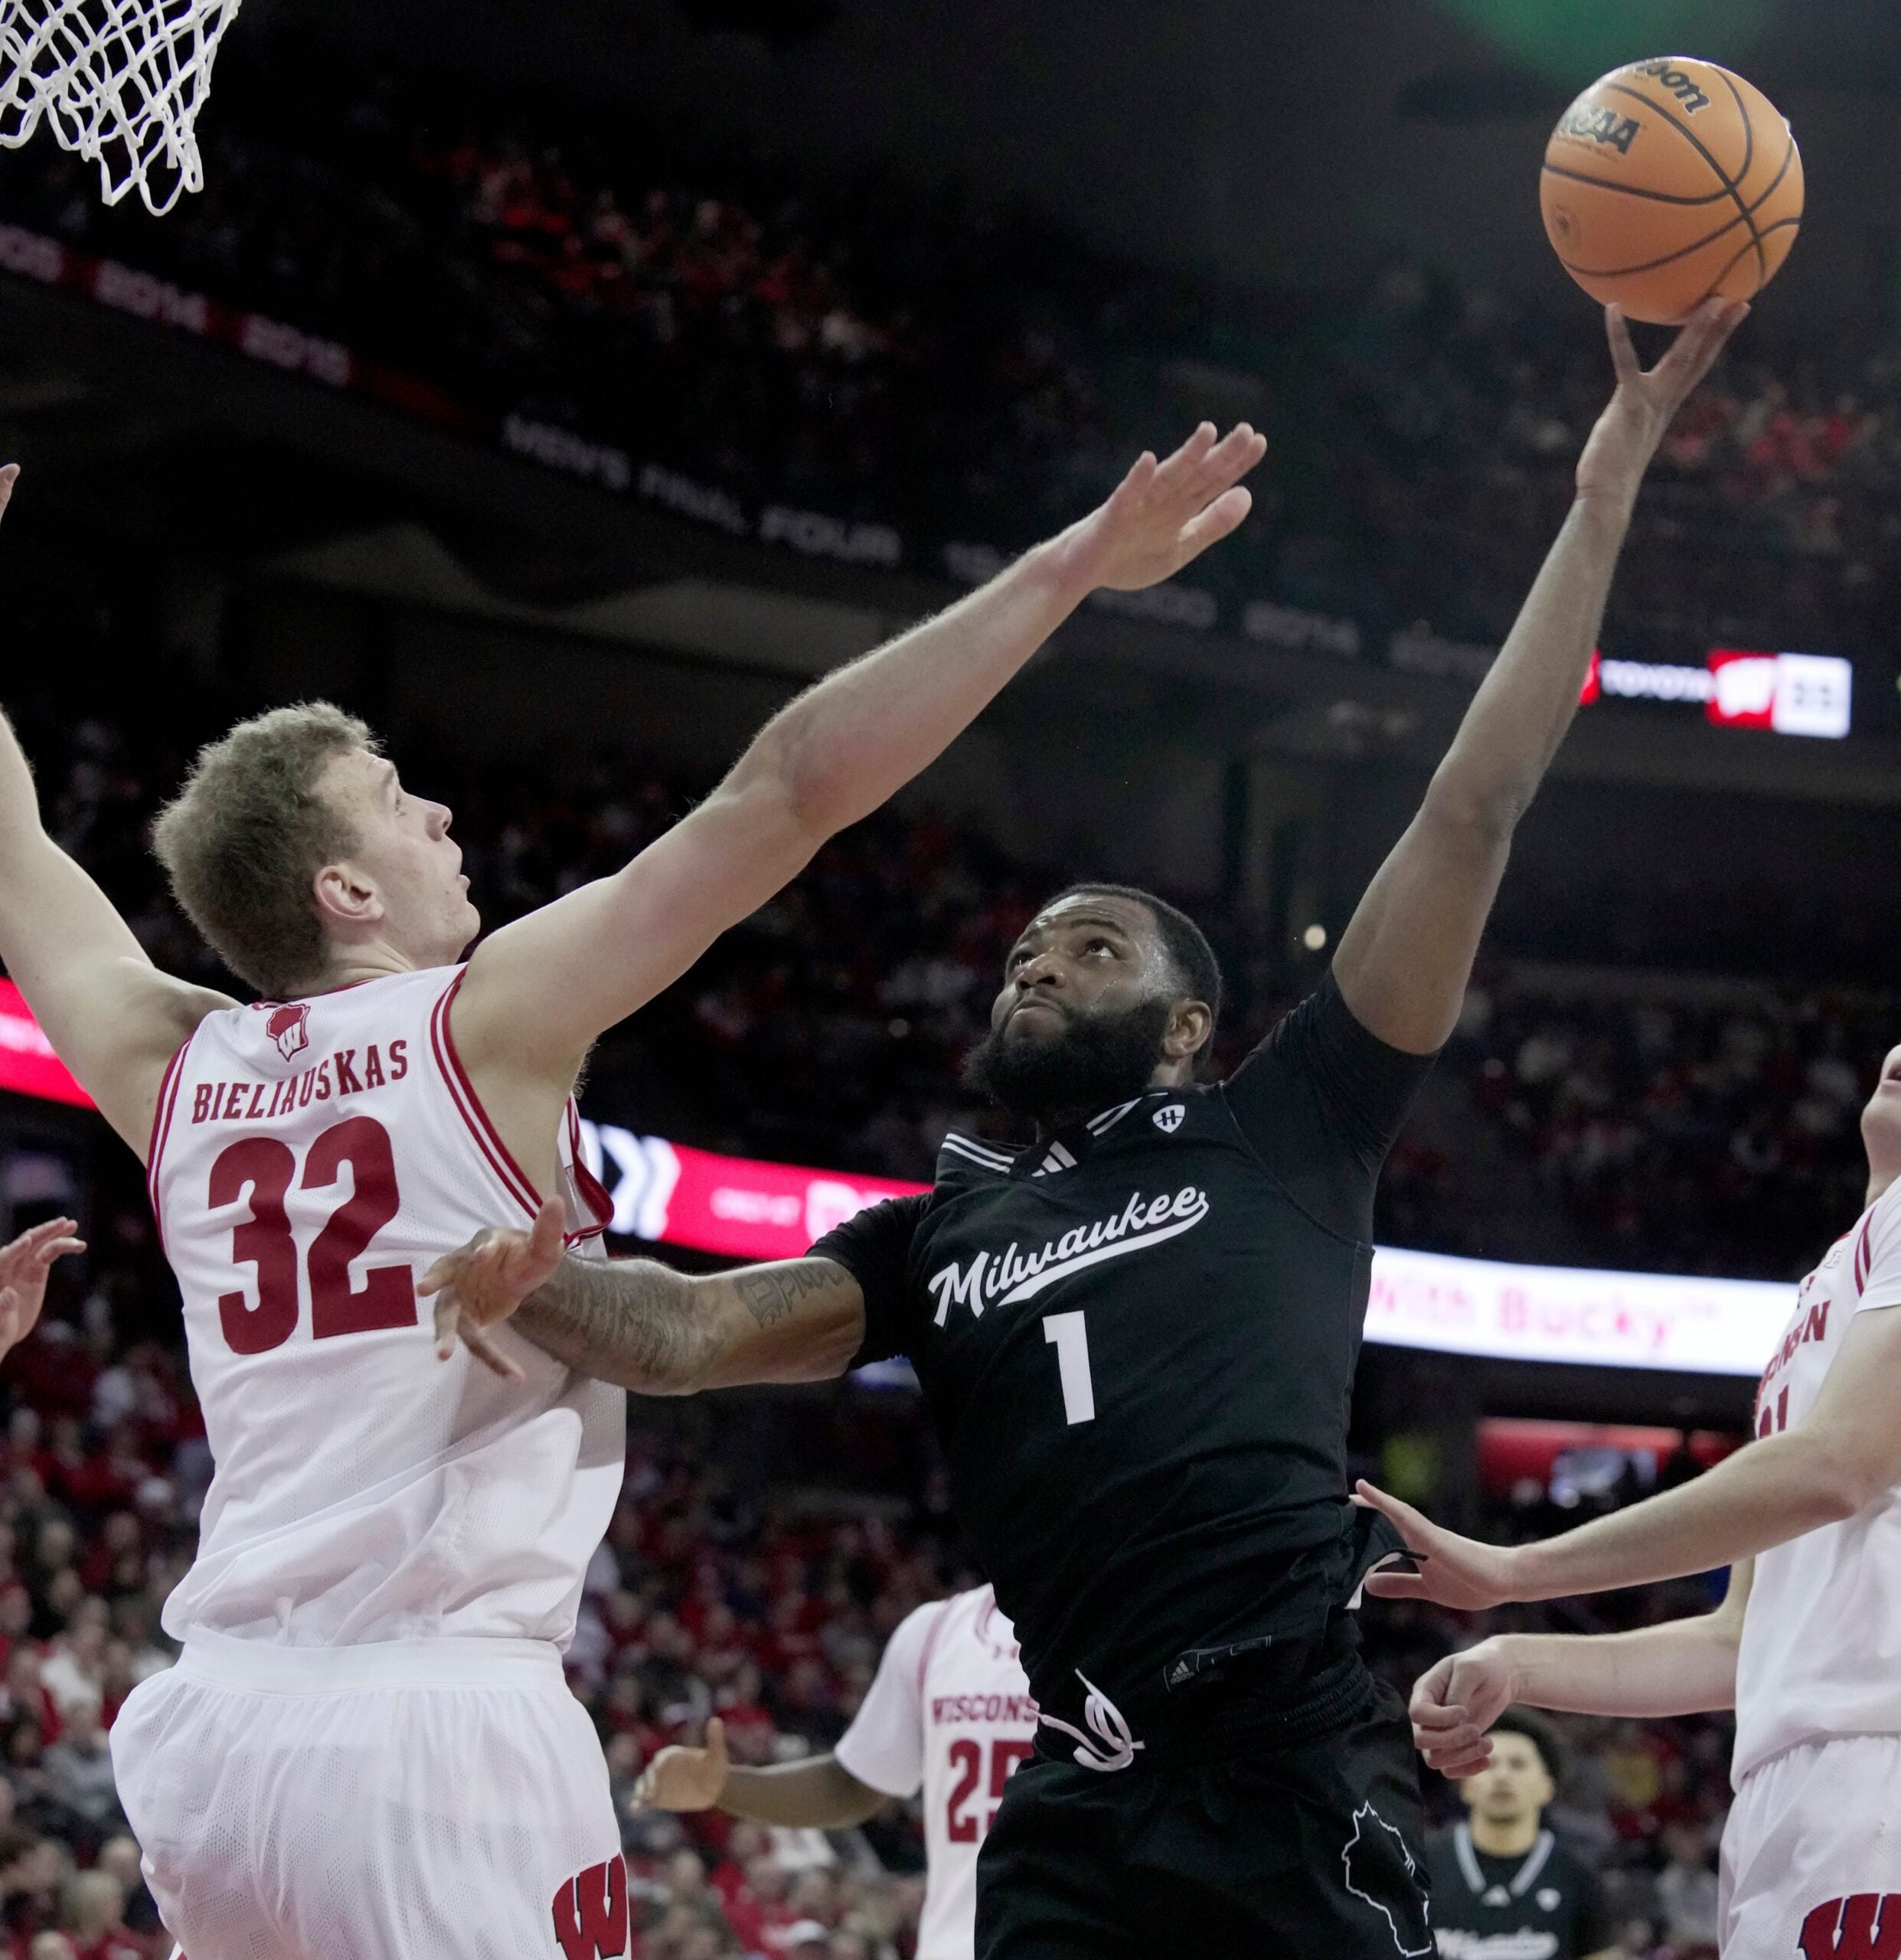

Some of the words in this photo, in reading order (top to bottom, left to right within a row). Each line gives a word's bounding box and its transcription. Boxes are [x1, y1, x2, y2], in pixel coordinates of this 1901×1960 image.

[191, 1040, 407, 1124] BIELIAUSKAS
[208, 1116, 419, 1355] 32
[928, 1186, 1210, 1328] Milwaukee
[1042, 1310, 1095, 1426] 1
